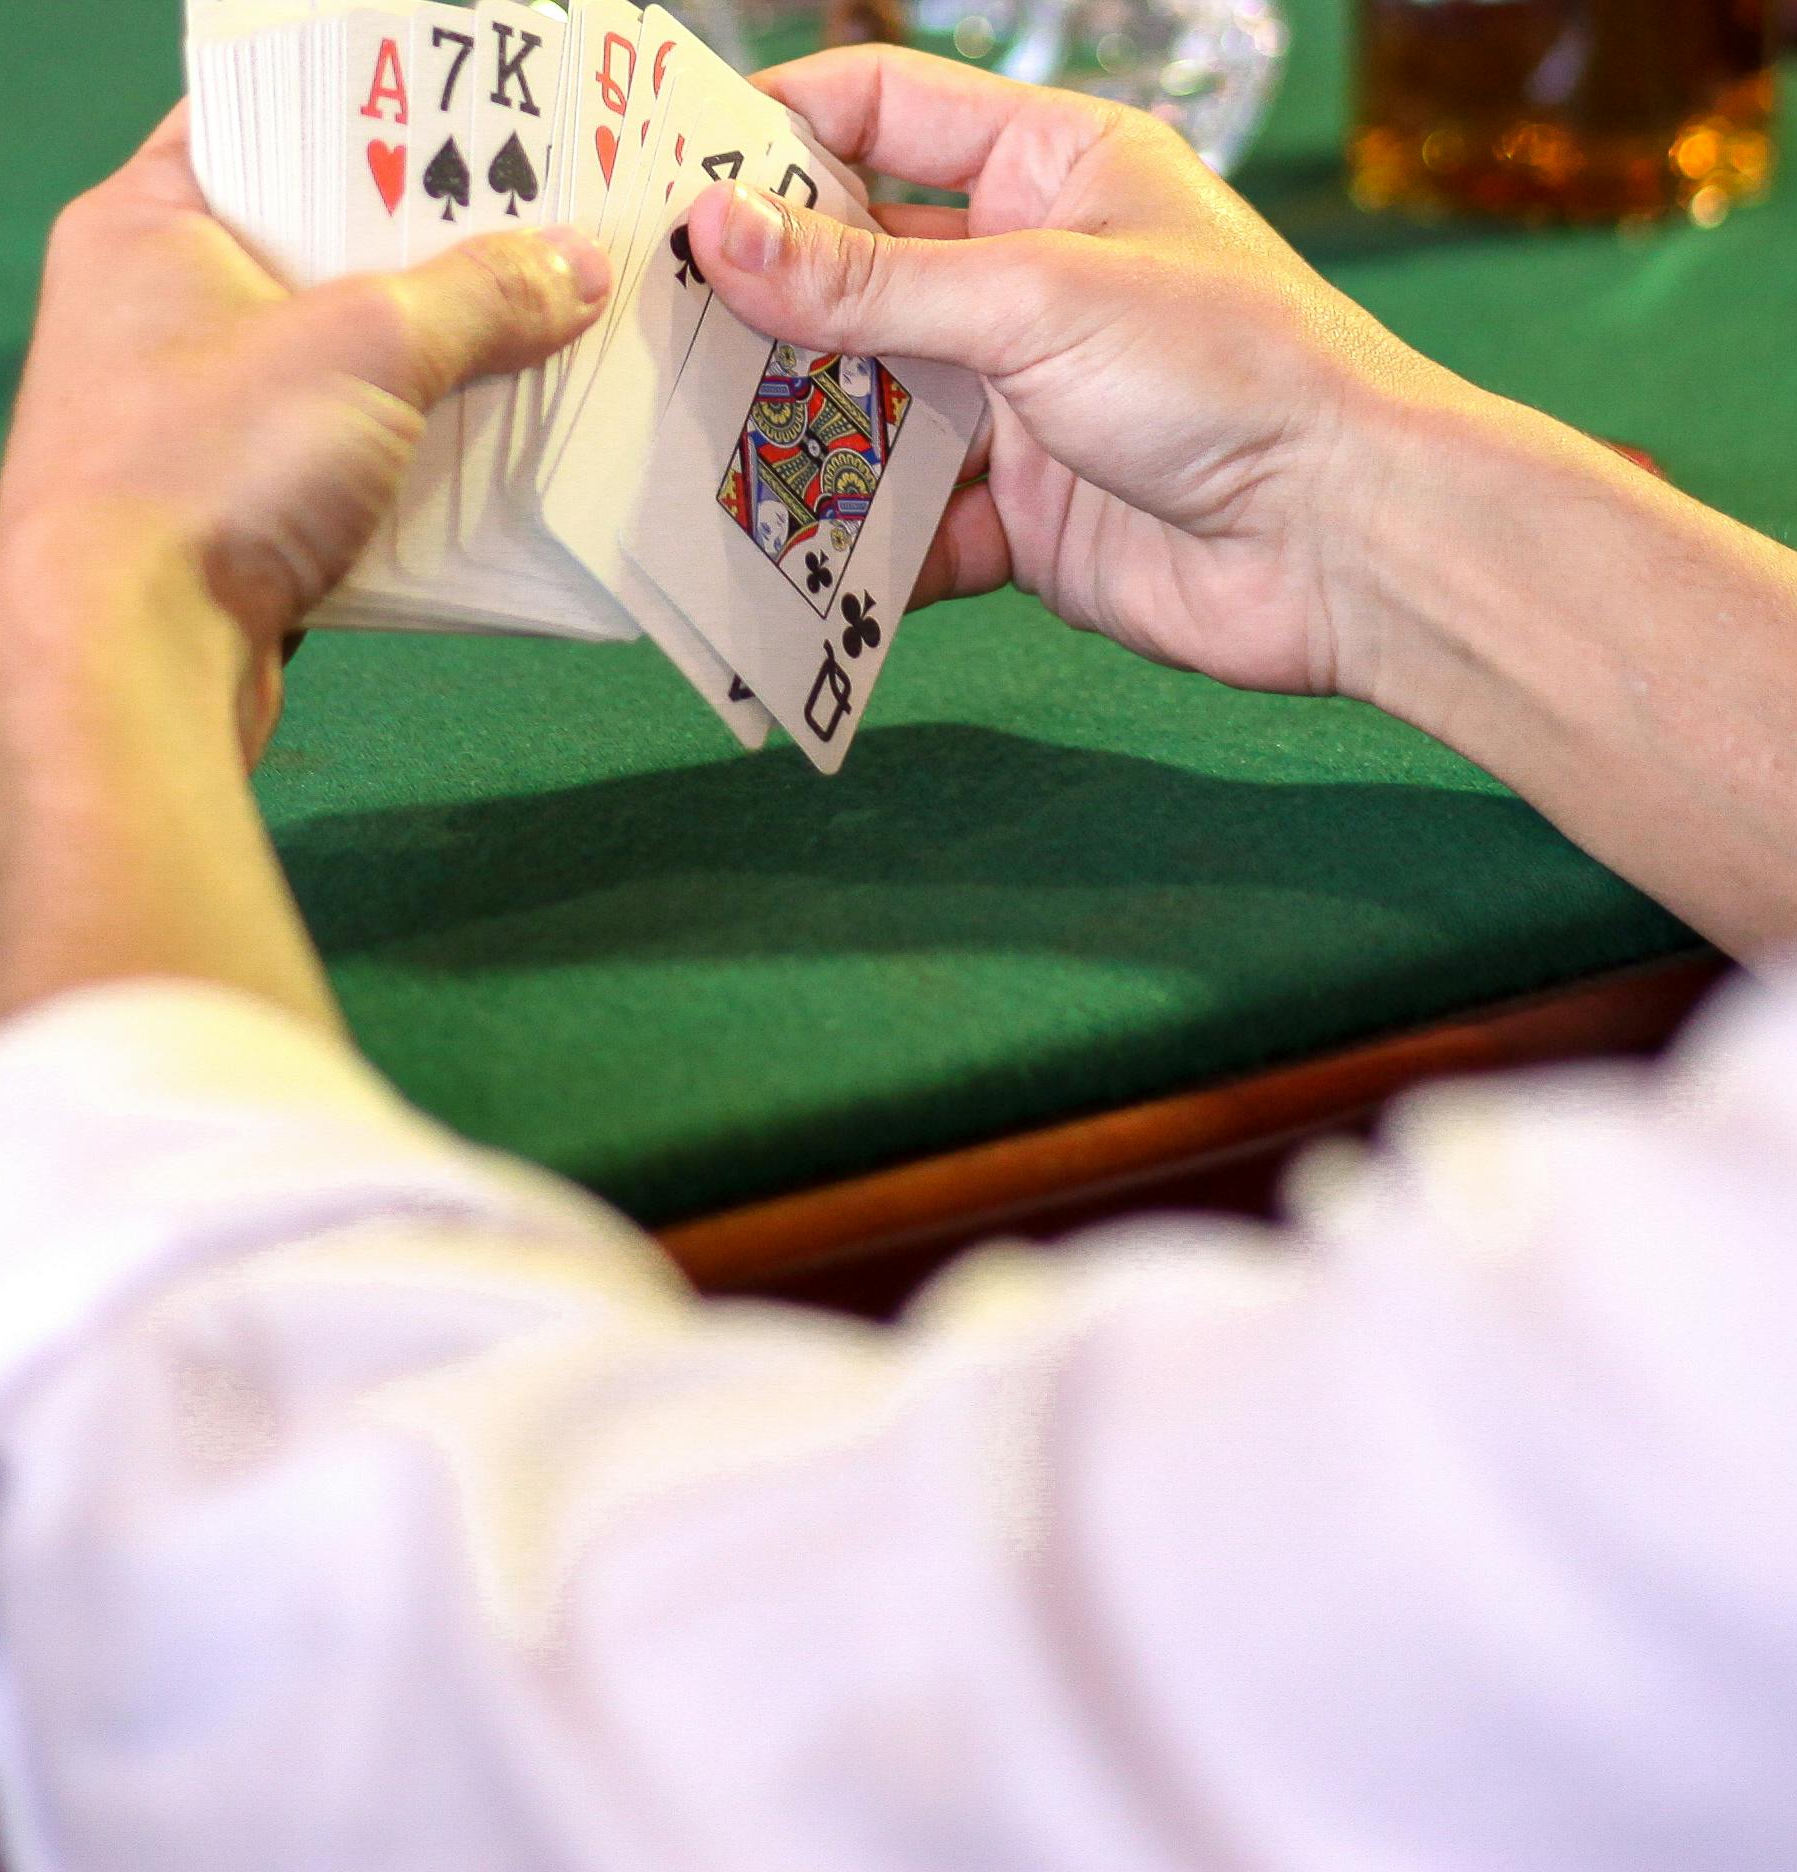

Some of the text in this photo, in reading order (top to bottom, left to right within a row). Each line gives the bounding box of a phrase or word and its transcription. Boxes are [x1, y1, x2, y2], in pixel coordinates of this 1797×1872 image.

[360, 38, 407, 125] A
[432, 26, 474, 112] 7
[490, 21, 541, 117] K
[595, 31, 637, 117] Q
[804, 639, 852, 742] Q
